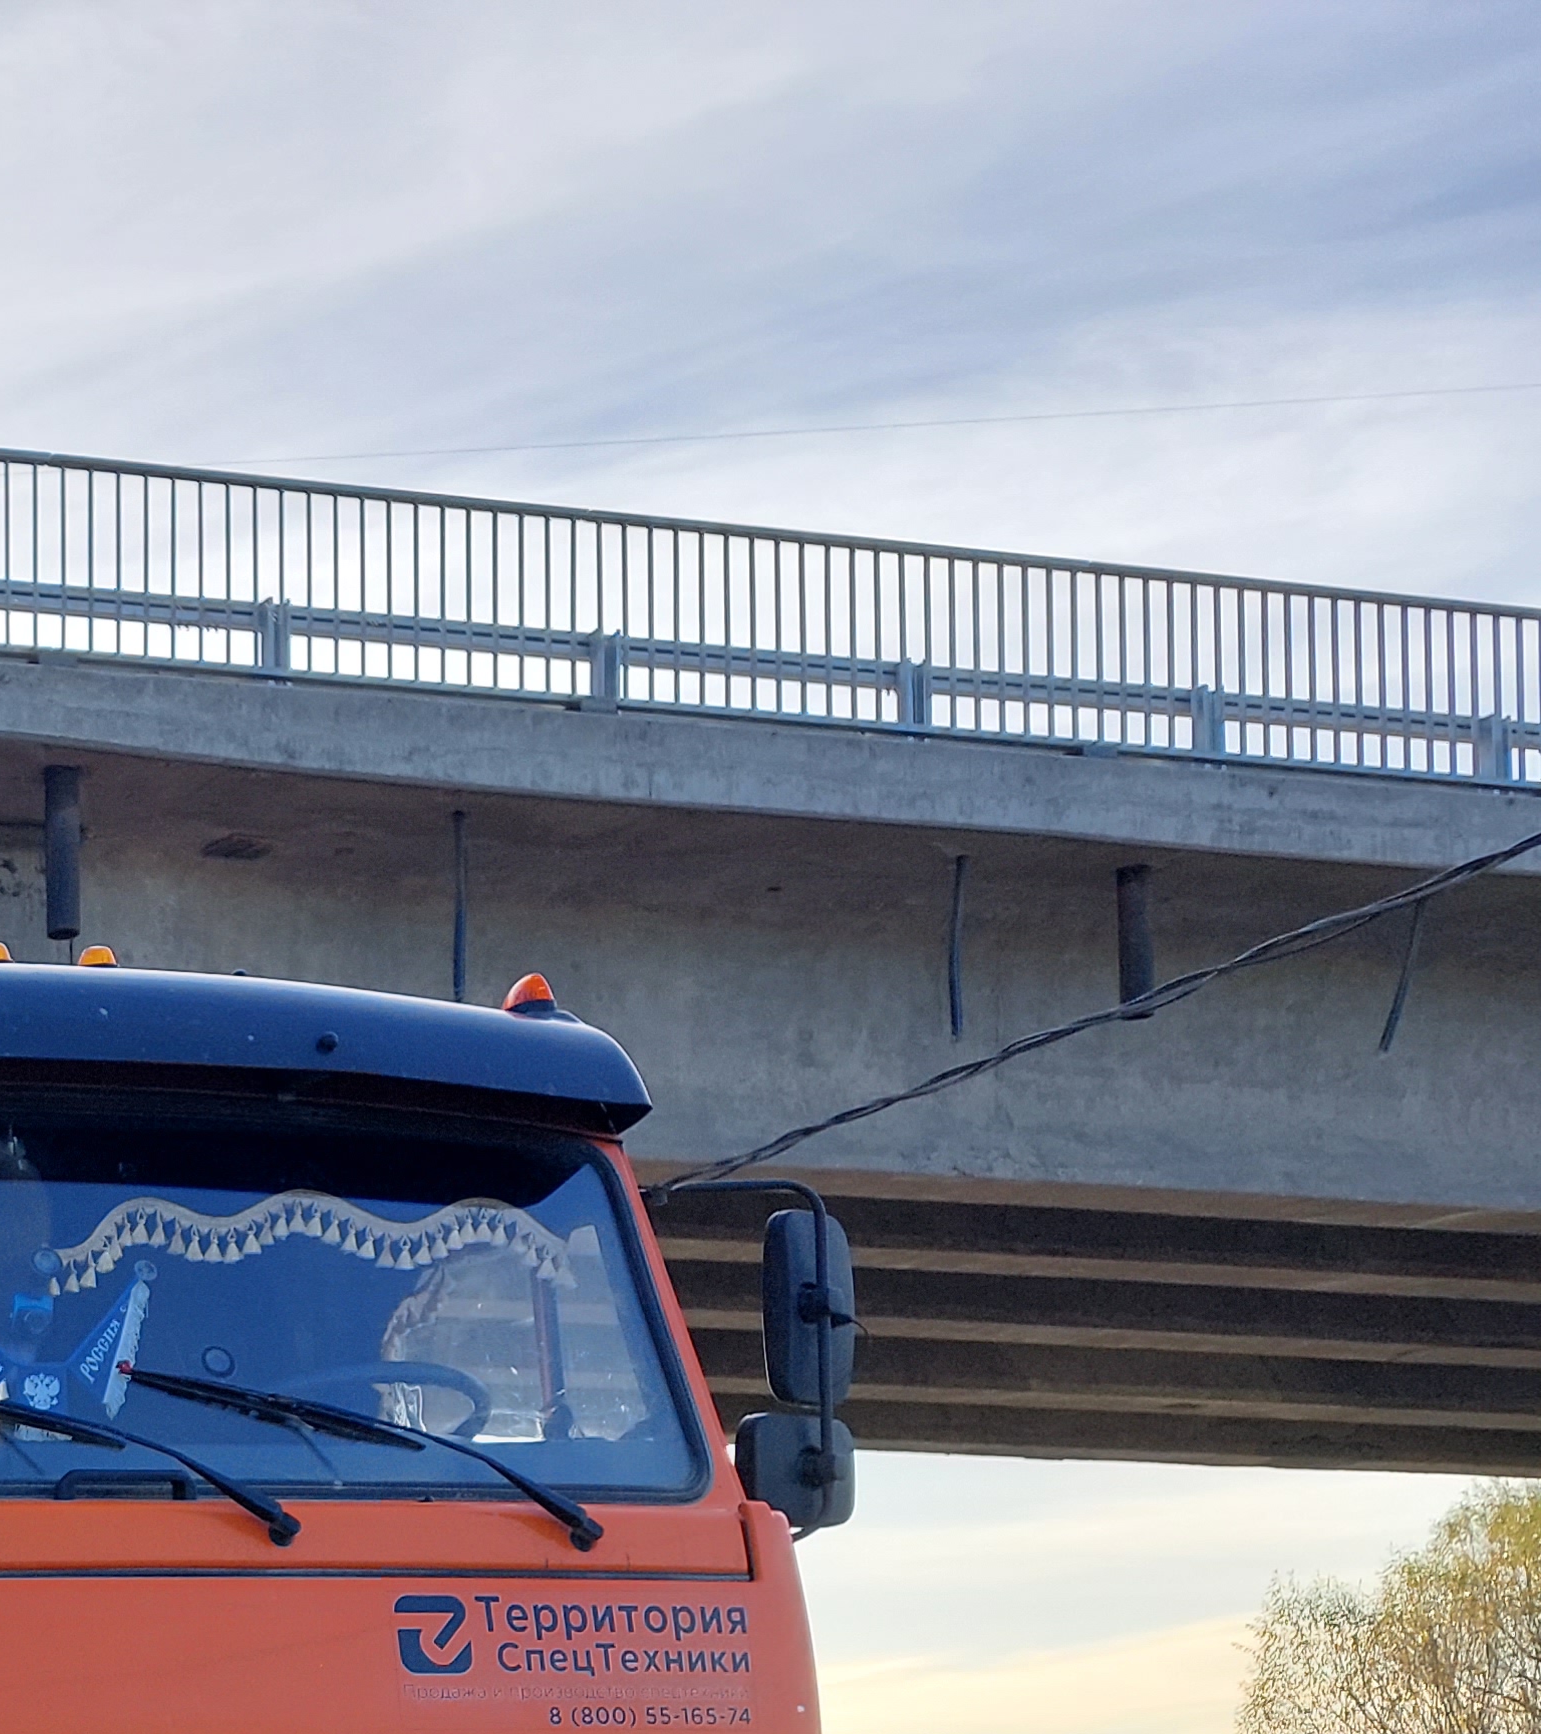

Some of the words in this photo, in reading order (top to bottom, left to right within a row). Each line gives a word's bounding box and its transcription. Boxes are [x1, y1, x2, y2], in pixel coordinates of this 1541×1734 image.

[474, 1595, 749, 1641] Территория
[497, 1642, 752, 1677] СпецТехники
[403, 1684, 487, 1700] Продажа
[549, 1706, 562, 1726] 8
[571, 1706, 637, 1728] (800)
[645, 1706, 751, 1726] 55-165-74
